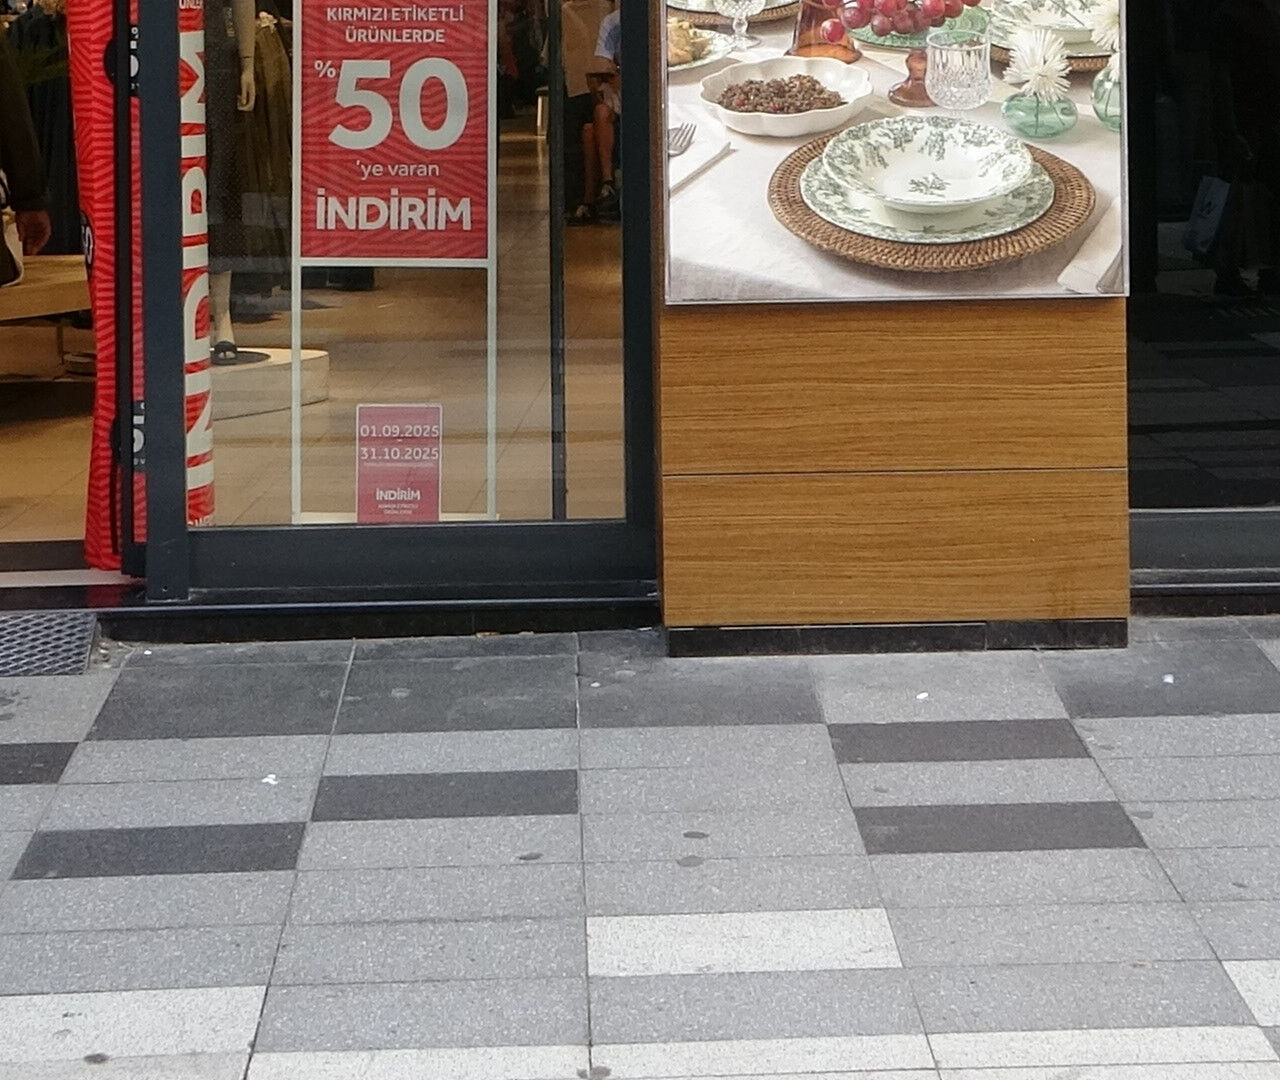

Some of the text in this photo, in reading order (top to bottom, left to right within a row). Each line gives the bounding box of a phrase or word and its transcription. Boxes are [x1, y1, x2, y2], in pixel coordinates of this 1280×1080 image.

[326, 4, 465, 22] KIRMIZI ETİKETLİ
[344, 25, 446, 44] ÜRÜNLERDE
[386, 161, 440, 177] varan
[314, 187, 472, 232] İNDİRİM
[359, 424, 440, 438] 01.09.2025
[359, 446, 440, 461] 31.10.2025
[375, 487, 422, 501] İNDİRİM
